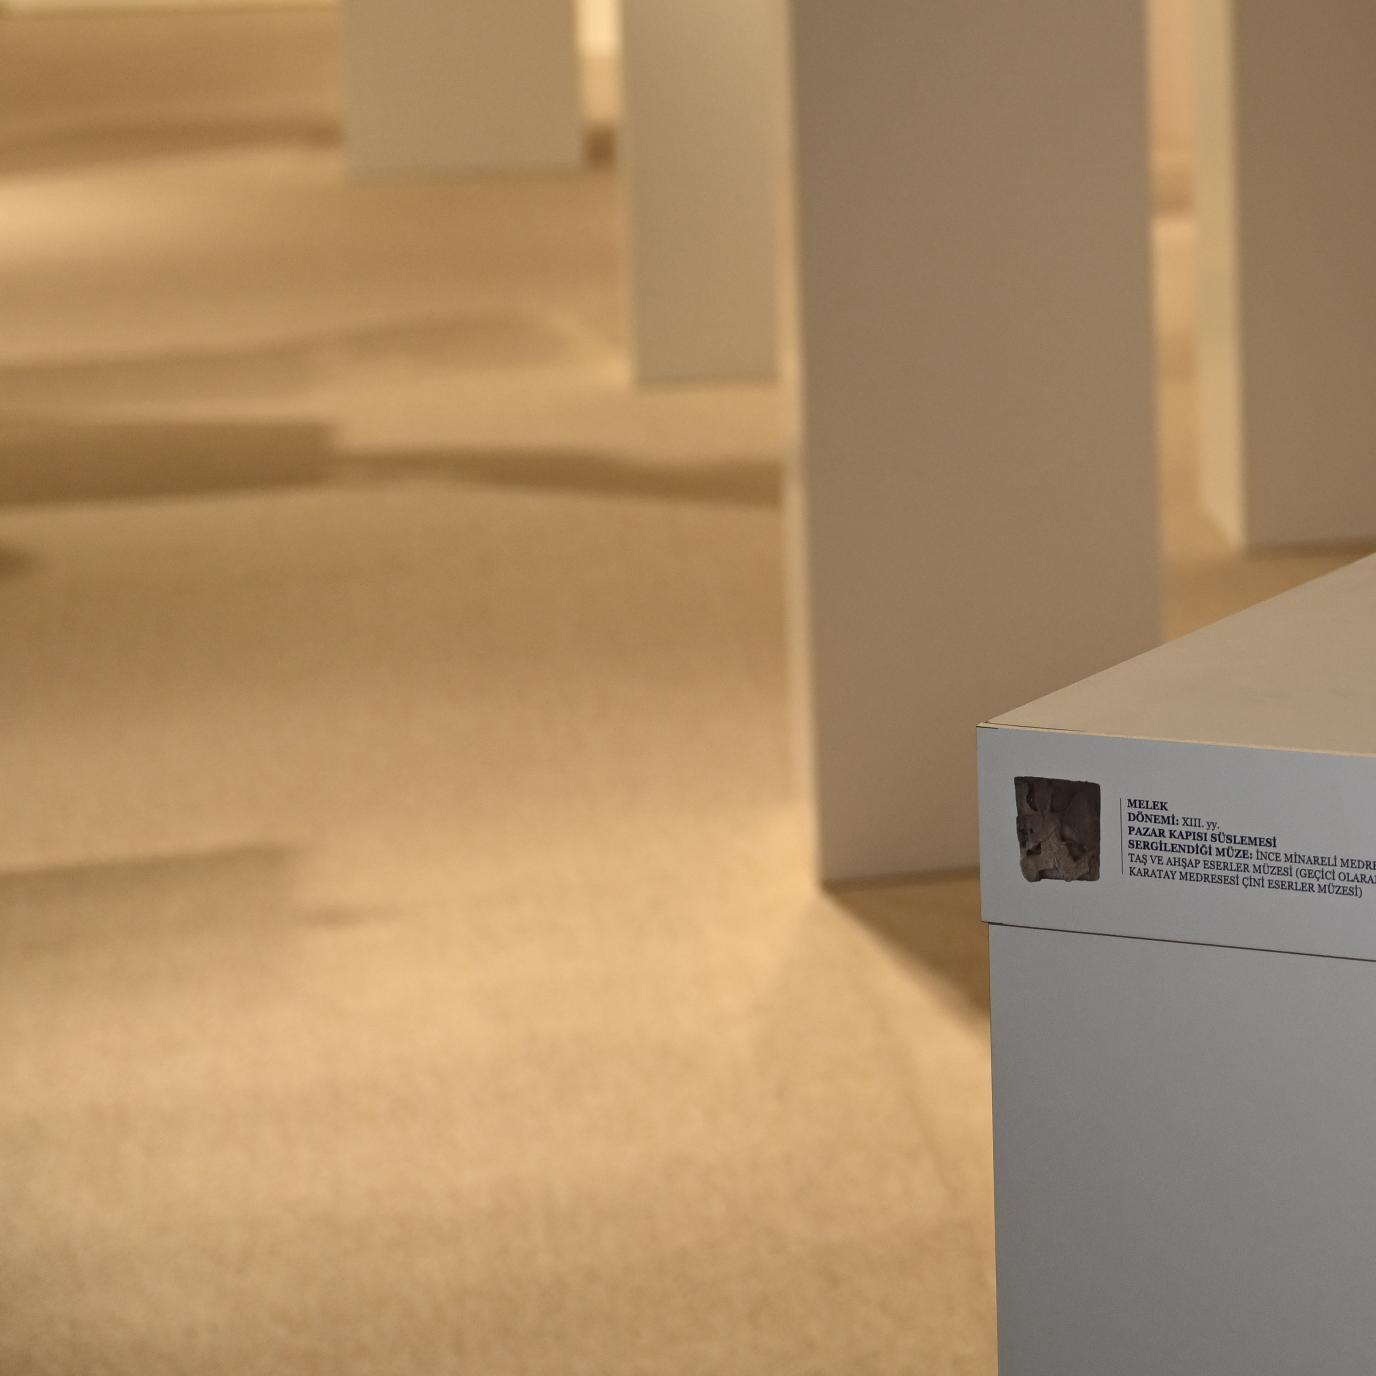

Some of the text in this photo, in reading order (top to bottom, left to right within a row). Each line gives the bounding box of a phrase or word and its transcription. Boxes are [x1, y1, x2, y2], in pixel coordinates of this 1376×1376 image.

[1127, 798, 1168, 811] MELEK
[1128, 811, 1220, 831] DÖNEMİ: XIII. yy.
[1128, 825, 1277, 848] PAZAR KAPISI SÜSLEMESİ
[1128, 839, 1212, 856] SERGİLENDİĞİ
[1215, 845, 1253, 860] MÜZE:
[1256, 848, 1281, 862] İNCE
[1284, 851, 1337, 867] MİNARELİ
[1128, 853, 1148, 866] TAŞ
[1150, 855, 1163, 865] VE
[1166, 857, 1201, 870] AHŞAP
[1203, 860, 1250, 874] ESERLER
[1252, 863, 1293, 877] MÜZESİ
[1295, 867, 1336, 882] (GEÇİCİ
[1129, 867, 1363, 899] KARATAY MEDRESESİ ÇİNİ ESERLER MÜZESİ)
